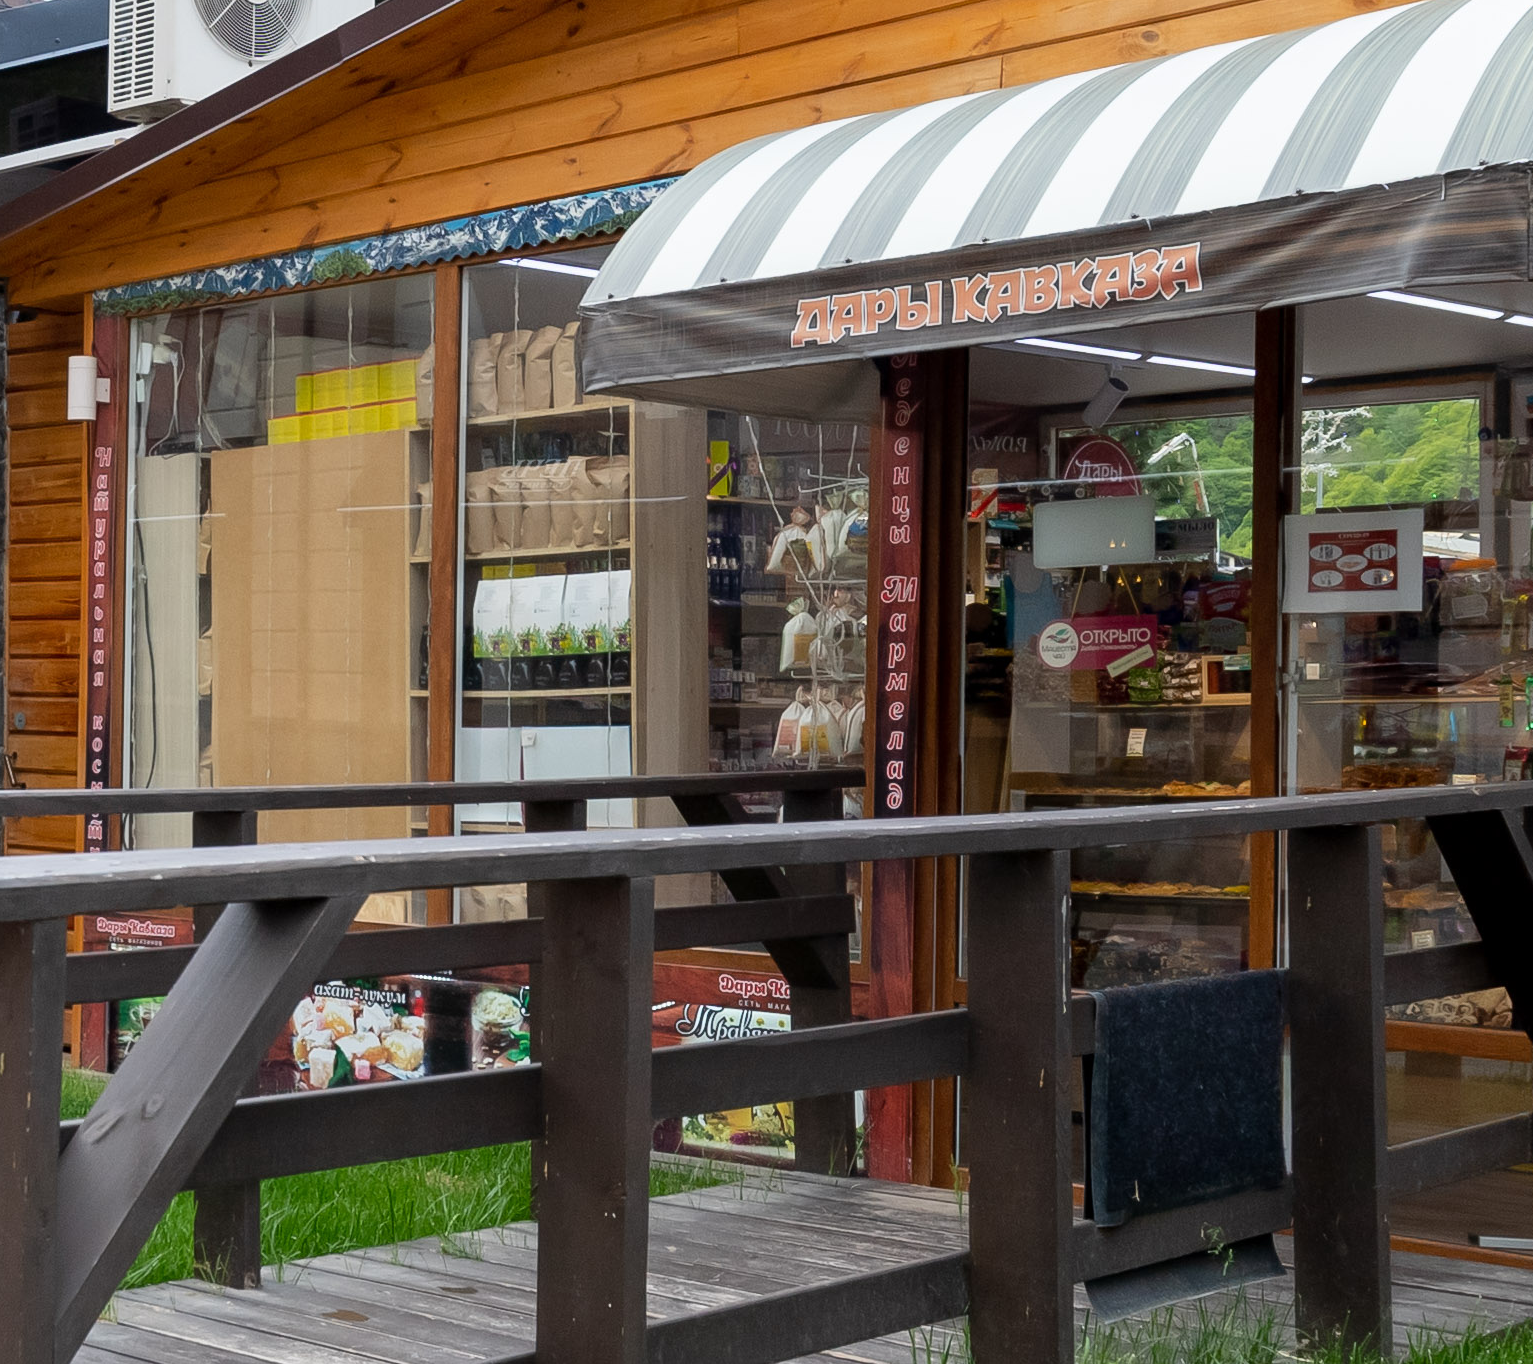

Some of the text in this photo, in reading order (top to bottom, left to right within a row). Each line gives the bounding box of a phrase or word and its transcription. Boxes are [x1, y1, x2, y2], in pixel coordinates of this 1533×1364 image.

[791, 242, 1203, 347] ДАРЫ КАВКАЗА
[93, 447, 112, 686] Натуральная
[1080, 628, 1151, 645] ОТКРЫТО
[881, 575, 918, 810] Мармелад
[97, 917, 175, 937] Дары Кавказа
[314, 984, 406, 1009] ахат-лукум
[719, 974, 767, 998] Дары
[738, 998, 761, 1008] СЕТЬ
